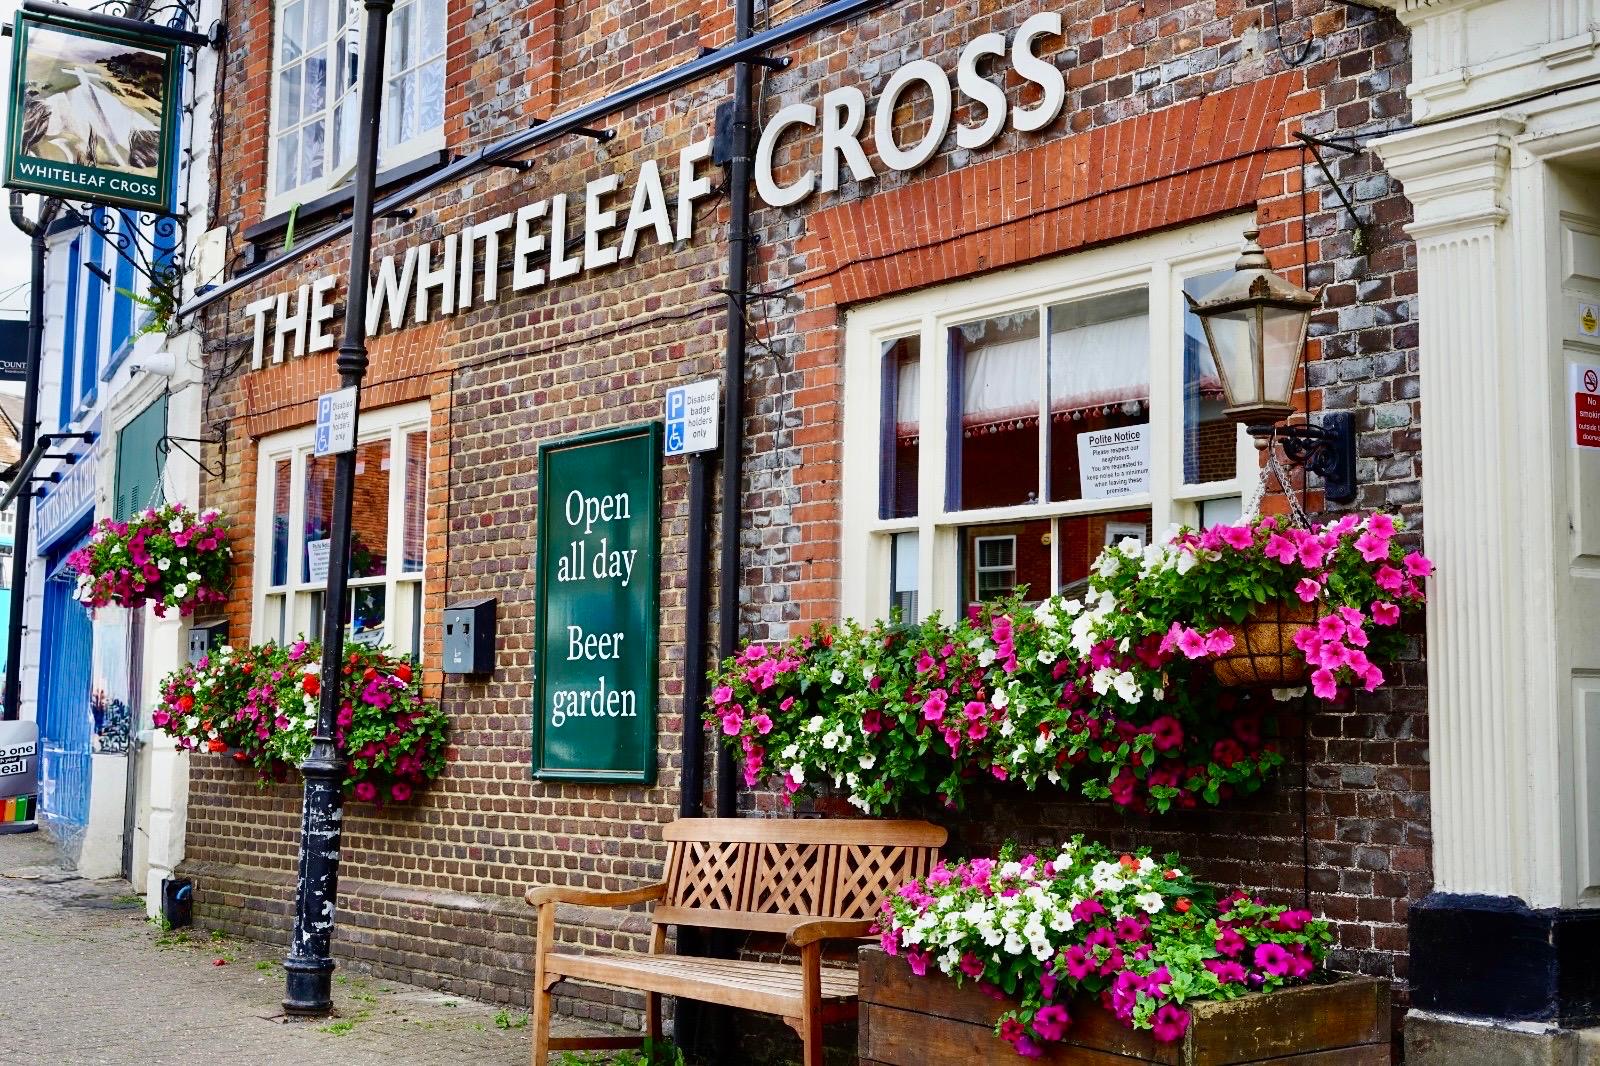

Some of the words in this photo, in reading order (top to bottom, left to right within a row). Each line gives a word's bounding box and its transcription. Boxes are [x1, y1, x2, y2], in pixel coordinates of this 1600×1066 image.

[20, 162, 106, 188] WHITELEAF
[110, 179, 157, 197] CROSS
[246, 275, 337, 370] THE
[365, 137, 714, 336] WHITELEAF
[755, 12, 1065, 207] CROSS
[687, 392, 716, 405] Disabled
[1587, 396, 1597, 406] No
[690, 406, 711, 416] badge
[688, 417, 713, 428] holders
[692, 428, 707, 438] only
[1089, 434, 1112, 446] Polite
[1114, 430, 1141, 442] Notice
[1110, 446, 1130, 454] respect
[1111, 461, 1137, 471] requested
[1125, 468, 1149, 476] minimum
[565, 489, 631, 535] Open
[557, 540, 586, 582] all
[592, 537, 638, 587] day
[566, 625, 625, 661] Beer
[551, 675, 637, 728] garden
[10, 745, 34, 755] one
